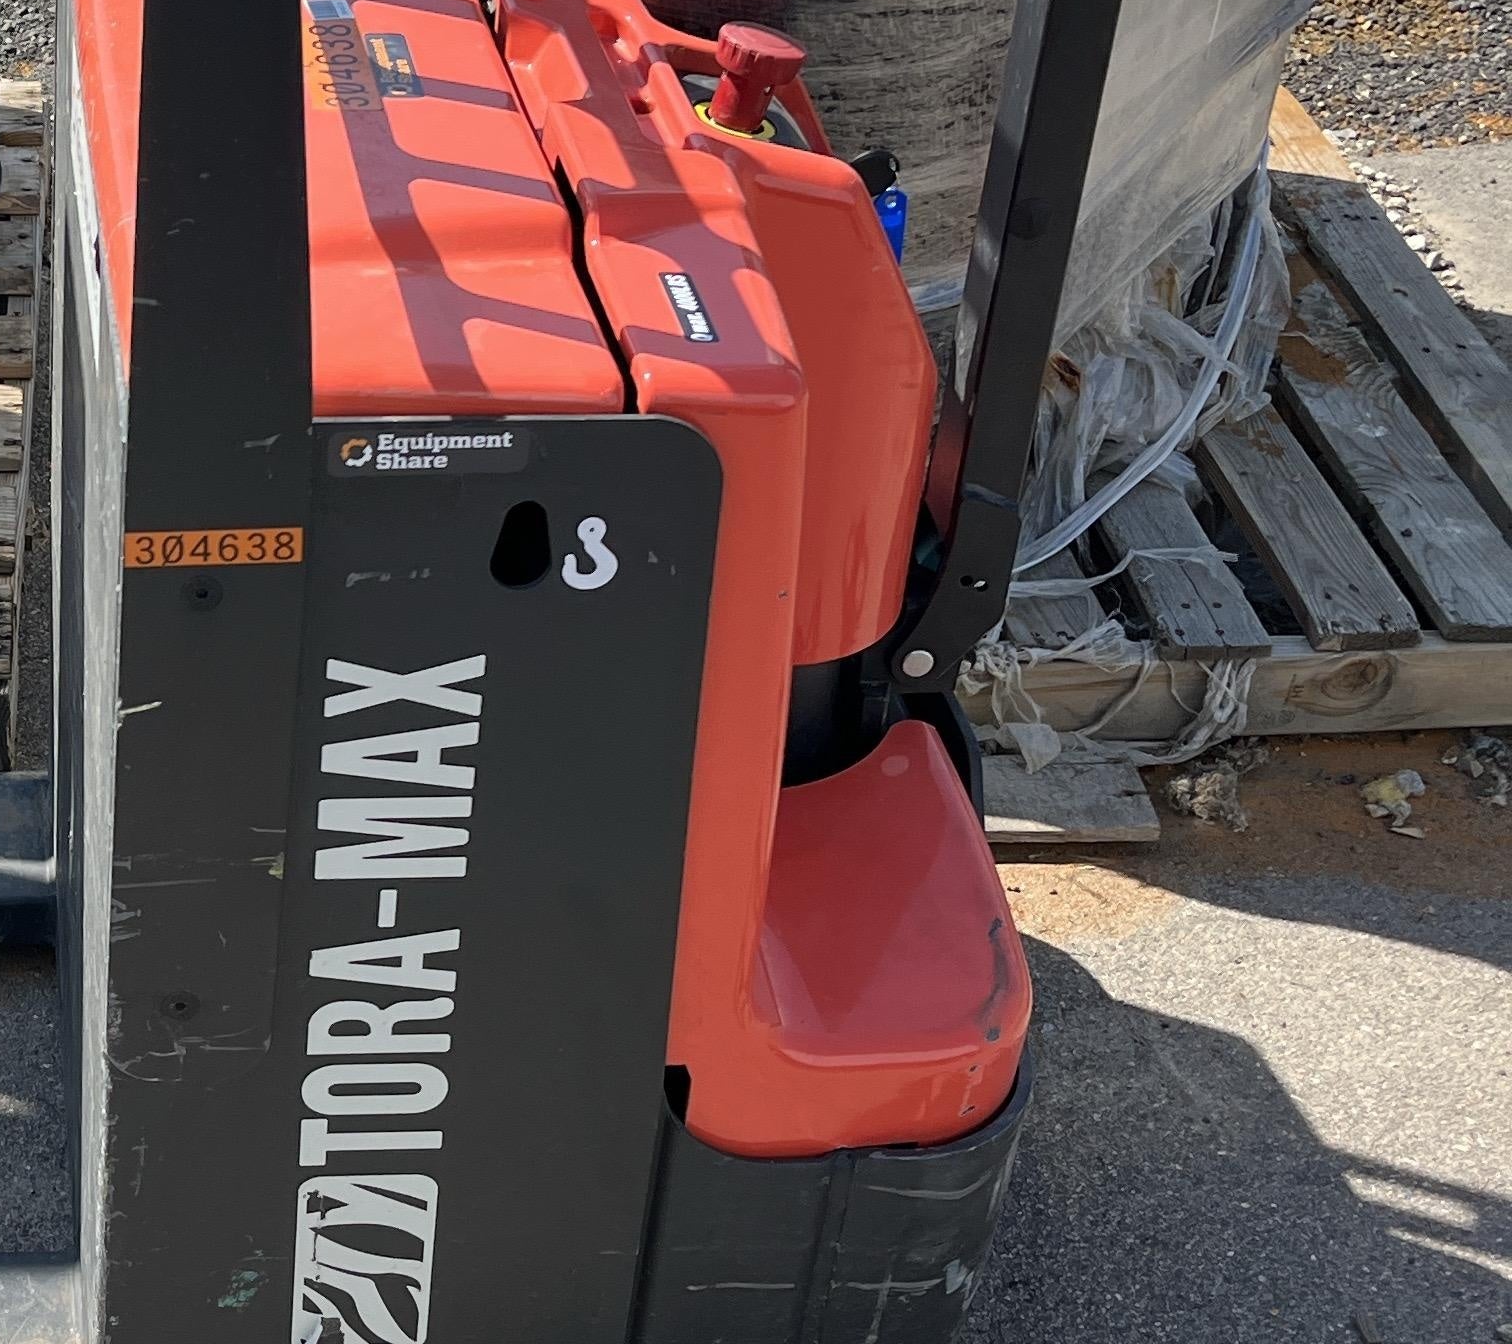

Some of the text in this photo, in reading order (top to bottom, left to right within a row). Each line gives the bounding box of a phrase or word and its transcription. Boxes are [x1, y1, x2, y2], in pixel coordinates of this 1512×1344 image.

[308, 24, 370, 108] 304638
[376, 432, 514, 453] Equipment
[375, 452, 449, 471] Share
[135, 531, 297, 566] 304638
[298, 654, 487, 1167] TORA-MAX
